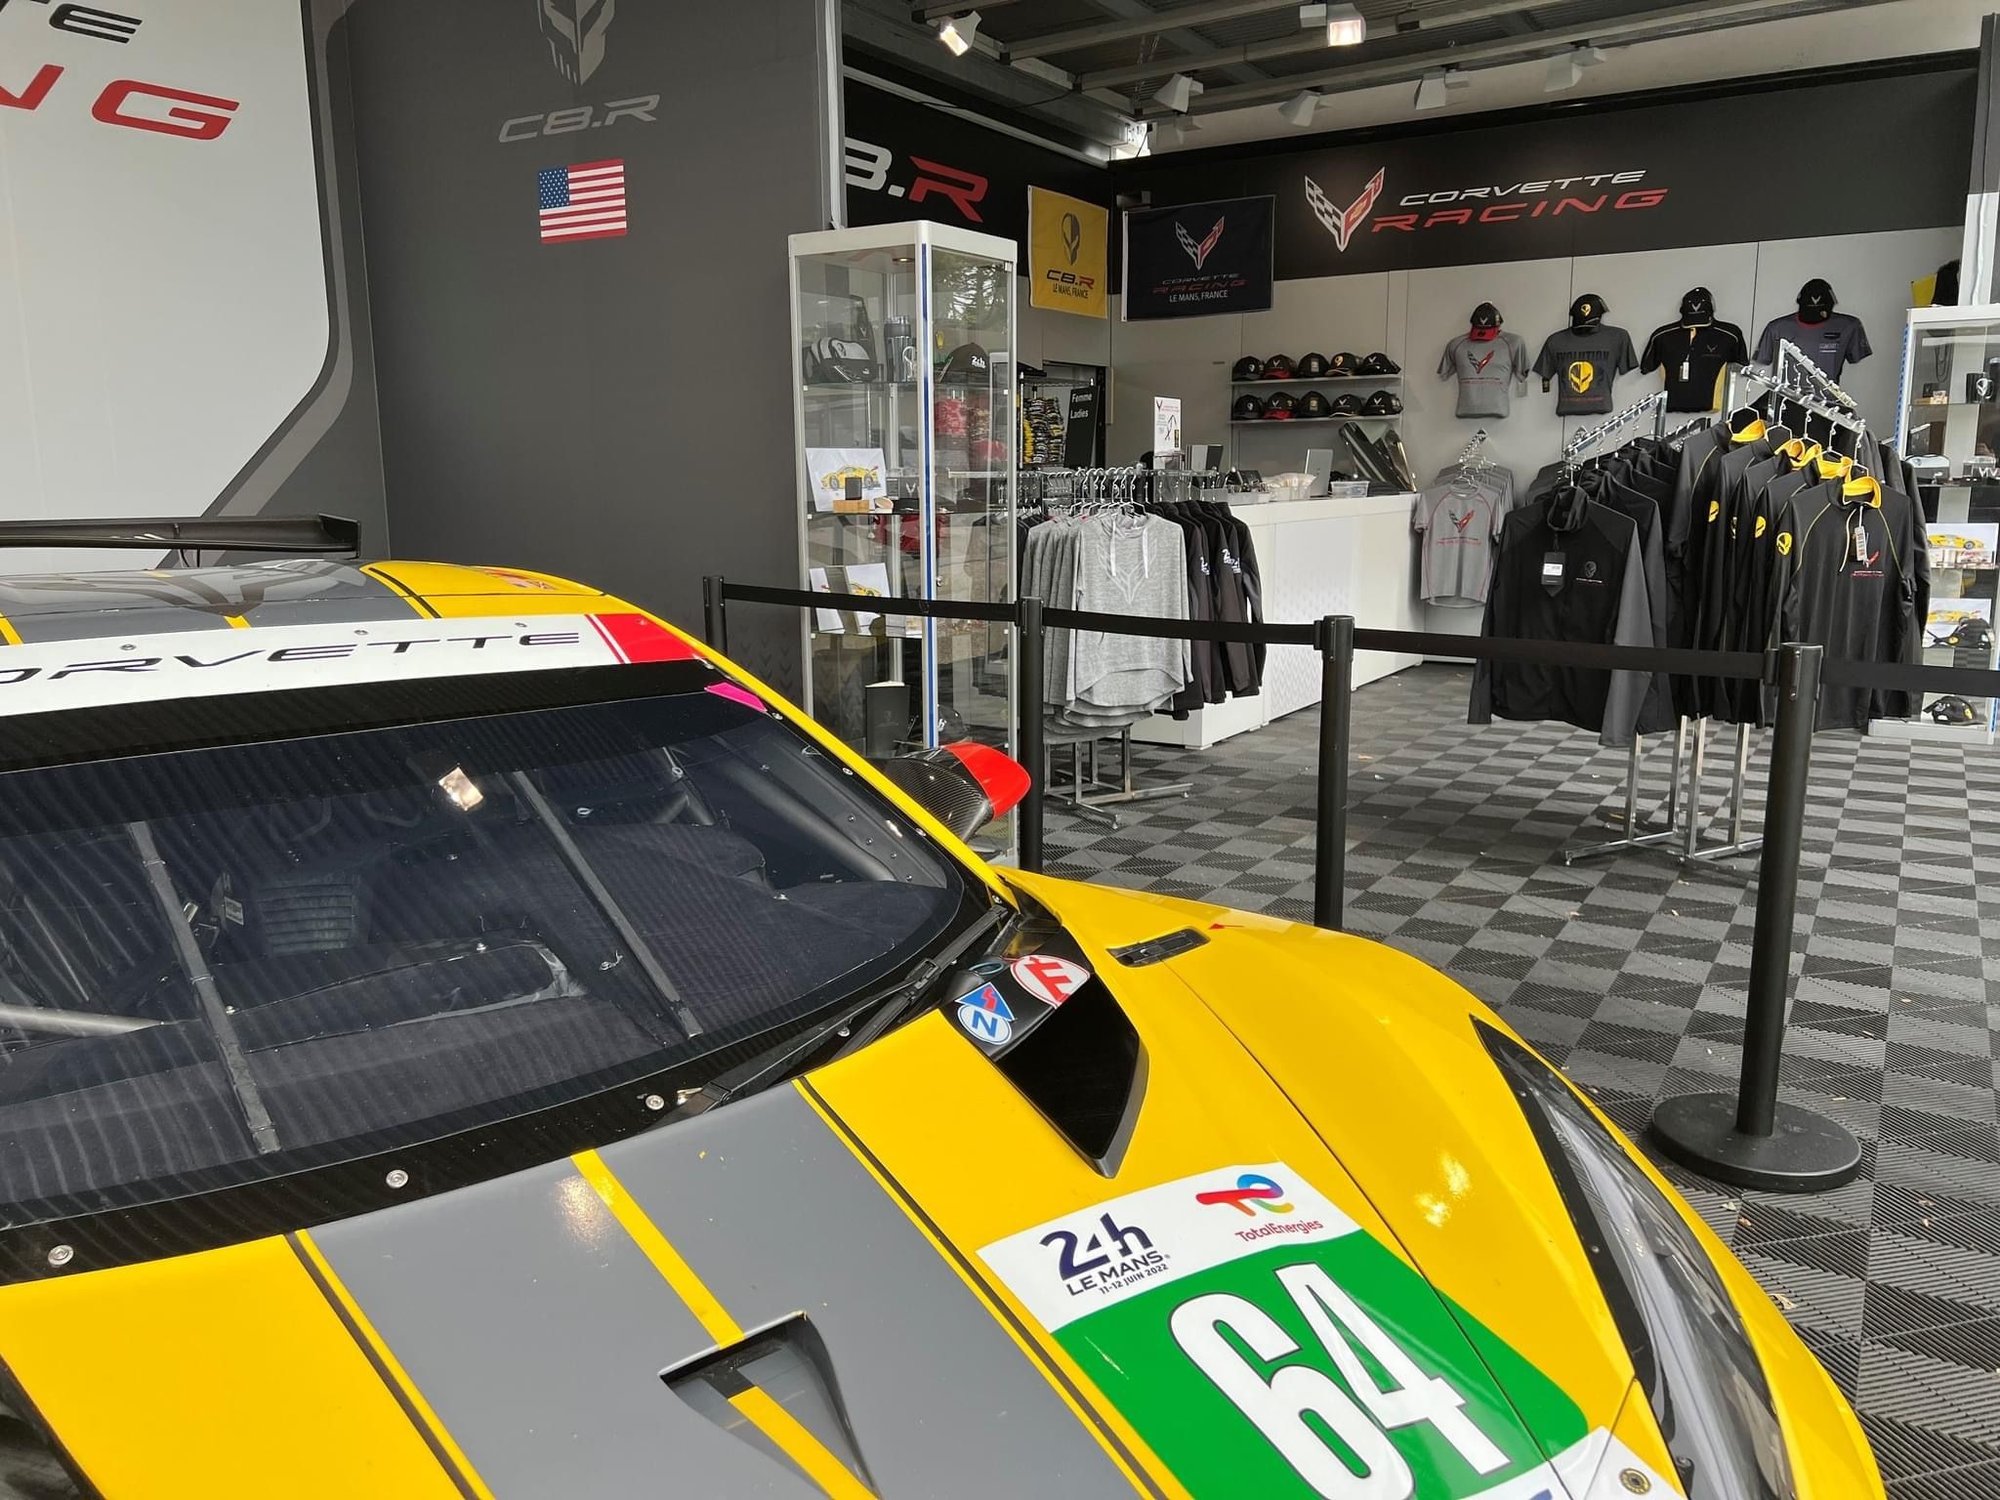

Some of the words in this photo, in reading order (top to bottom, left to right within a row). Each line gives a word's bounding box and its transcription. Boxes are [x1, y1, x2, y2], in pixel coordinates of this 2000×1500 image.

[499, 94, 660, 142] C8.R
[1400, 170, 1646, 206] CORVETTE
[1371, 188, 1668, 233] RACING
[1047, 270, 1094, 289] C8.R
[1152, 279, 1247, 294] RACING
[1162, 273, 1240, 285] CORVETTE
[1169, 294, 1177, 303] LE
[1201, 289, 1229, 300] FRANCE
[1070, 408, 1089, 419] Ladies
[1235, 1220, 1324, 1241] TotalEnergies
[1039, 1212, 1154, 1281] 24h
[1066, 1275, 1098, 1296] LE
[1099, 1281, 1124, 1295] 11-12
[1124, 1272, 1145, 1286] JUIN
[1146, 1262, 1169, 1277] 2022
[1168, 1261, 1512, 1500] 64
